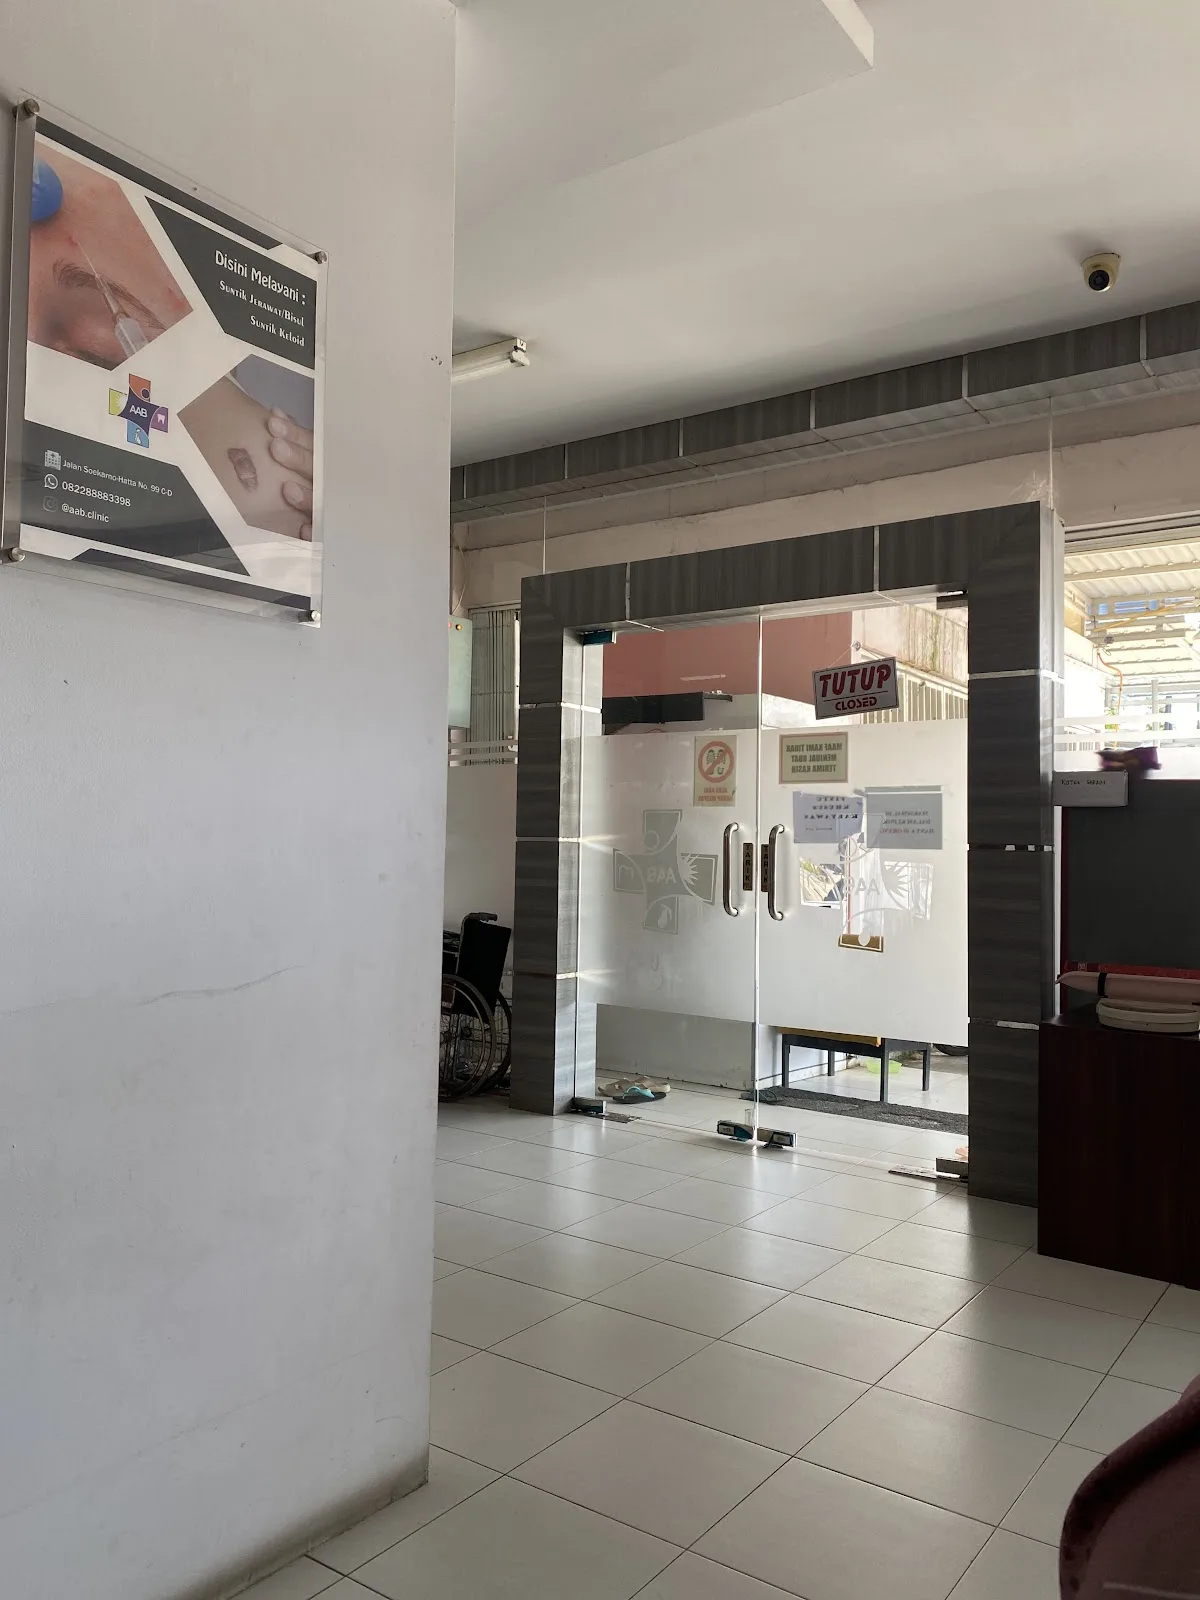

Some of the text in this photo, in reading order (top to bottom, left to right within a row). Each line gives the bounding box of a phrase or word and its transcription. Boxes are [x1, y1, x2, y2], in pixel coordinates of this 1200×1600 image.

[215, 250, 248, 278] Disini
[251, 267, 299, 303] Melayani
[129, 404, 148, 418] AAB
[62, 460, 173, 497] Jalan Soekarno-Hatta No. 99 C-D
[61, 481, 131, 507] 082288883398
[61, 503, 110, 523] @aab.clinic
[819, 664, 892, 698] TUTUP
[835, 696, 878, 711] CLOSED
